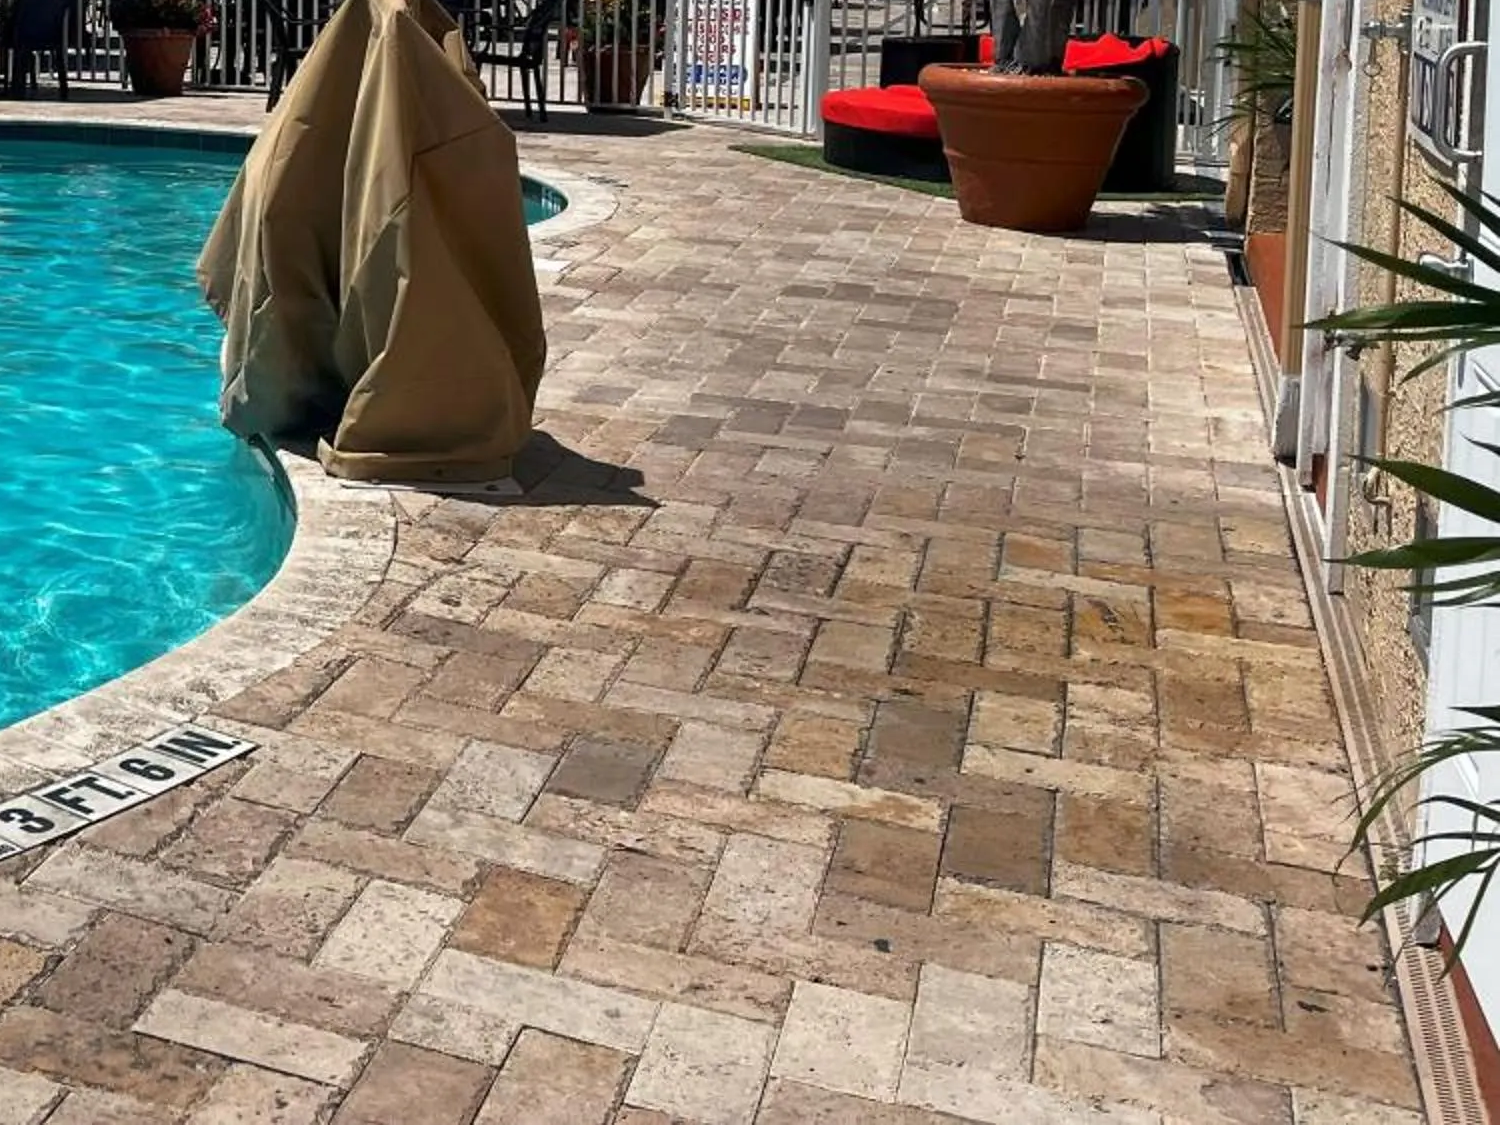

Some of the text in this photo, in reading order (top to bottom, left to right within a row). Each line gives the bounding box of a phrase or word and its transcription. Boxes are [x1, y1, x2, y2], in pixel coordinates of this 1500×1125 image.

[42, 775, 136, 815] FT.
[118, 757, 175, 782] 6
[155, 730, 241, 764] IN.
